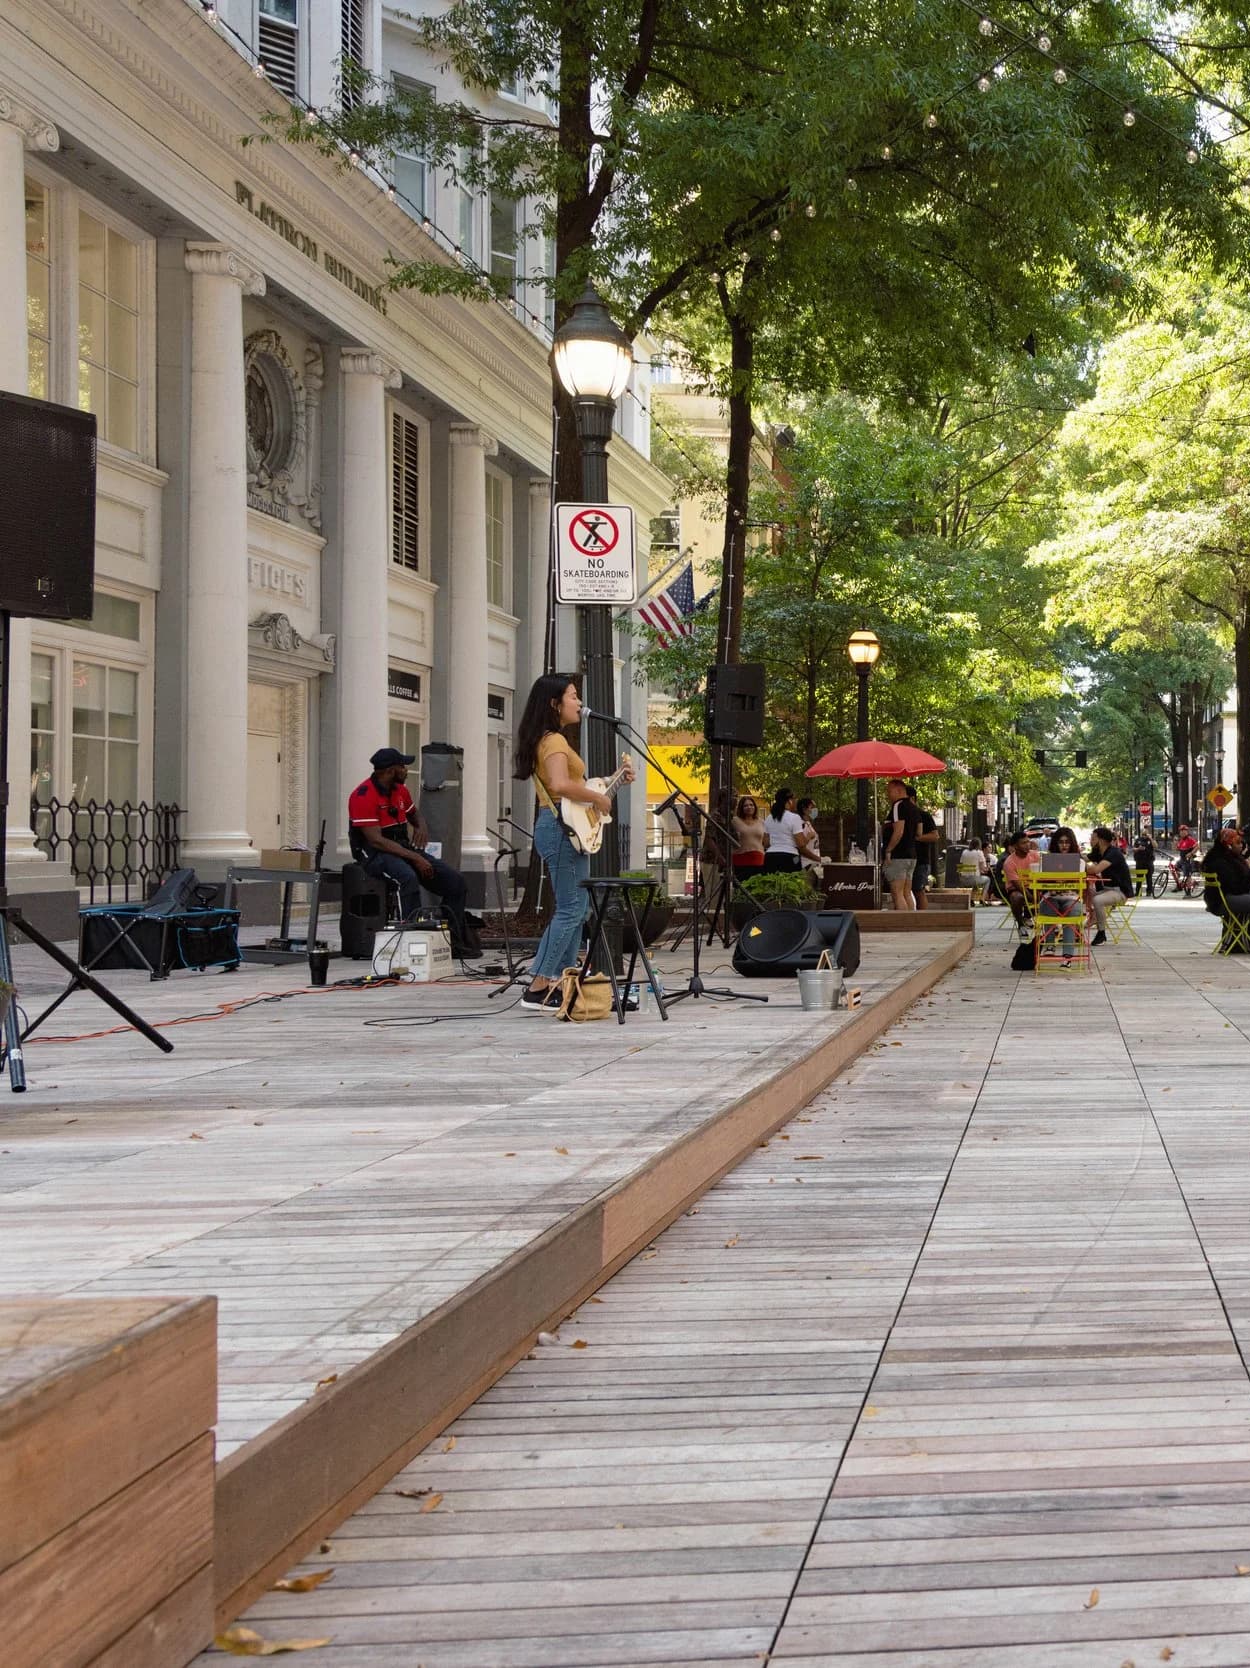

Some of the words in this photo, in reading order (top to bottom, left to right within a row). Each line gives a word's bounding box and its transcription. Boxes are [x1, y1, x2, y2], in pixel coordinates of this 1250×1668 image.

[235, 181, 318, 262] FLATIRON
[324, 252, 387, 316] BUILDING
[587, 559, 605, 568] NO
[563, 569, 629, 578] SKATEBOARDING
[396, 686, 413, 698] COFFEE
[1139, 803, 1151, 812] STOP
